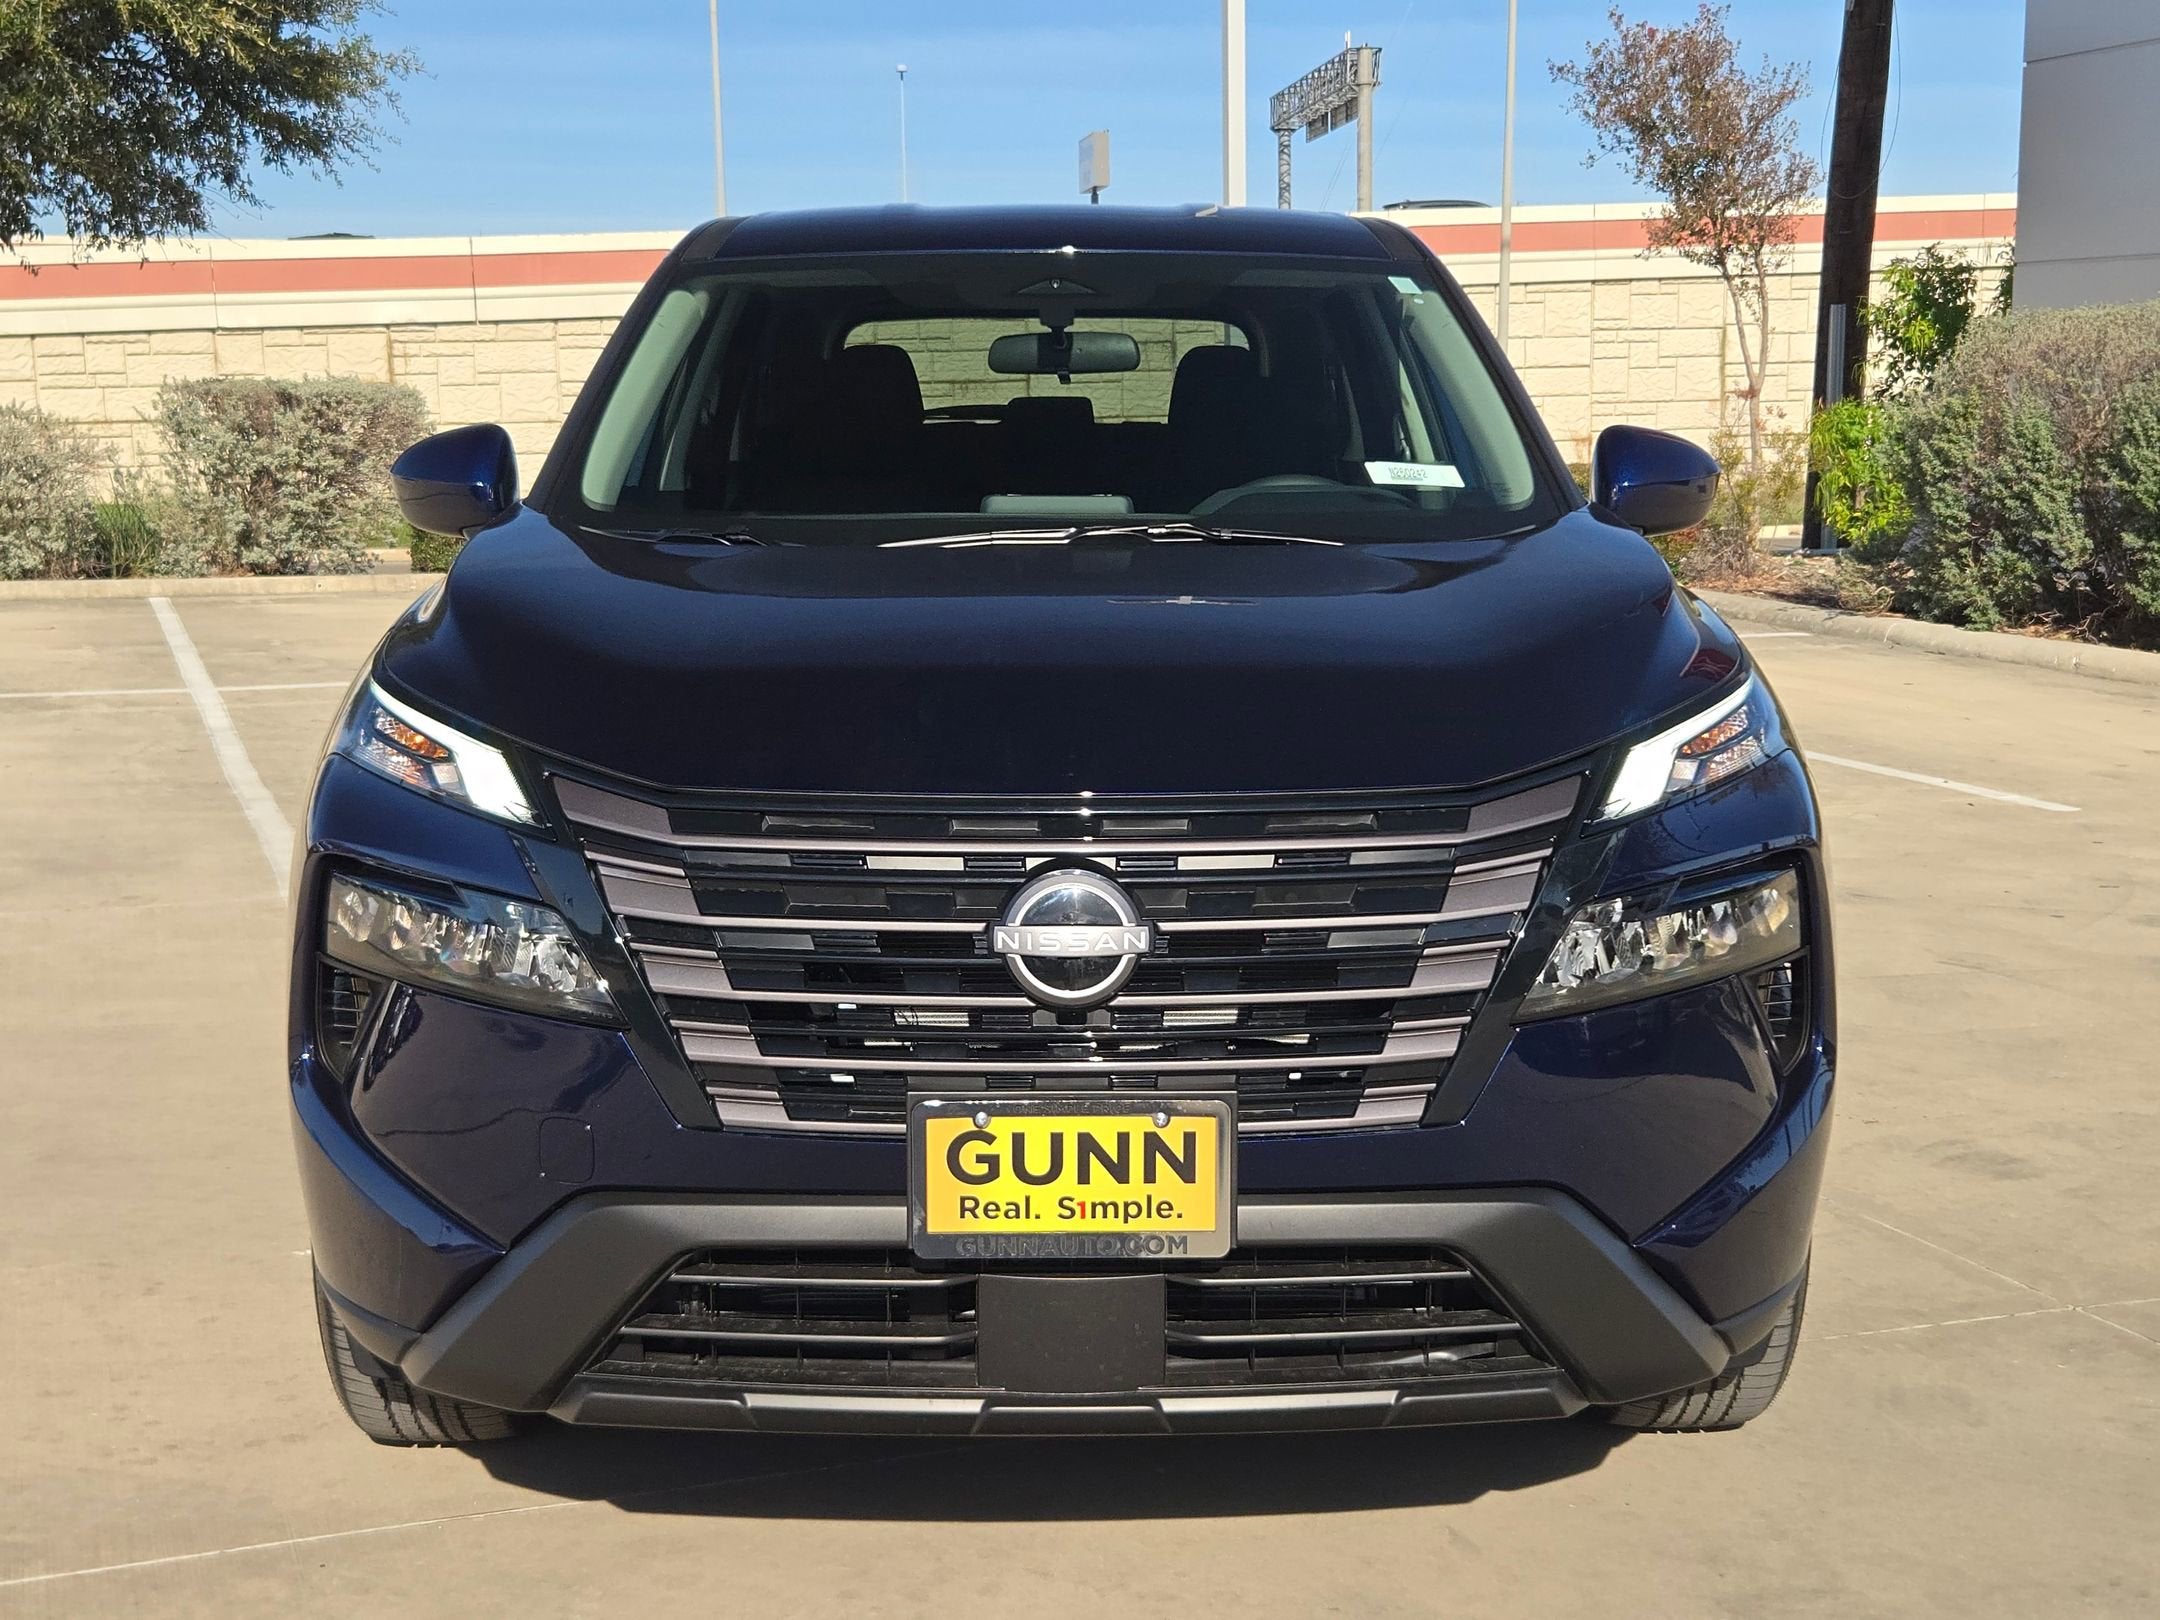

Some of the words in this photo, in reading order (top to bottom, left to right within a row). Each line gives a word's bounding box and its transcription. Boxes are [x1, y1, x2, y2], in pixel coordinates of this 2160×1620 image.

[996, 930, 1147, 951] NISSAN
[946, 1130, 1197, 1185] GUNN
[959, 1195, 1041, 1219] Real.
[955, 1235, 1188, 1256] GUNNAUTO.COM
